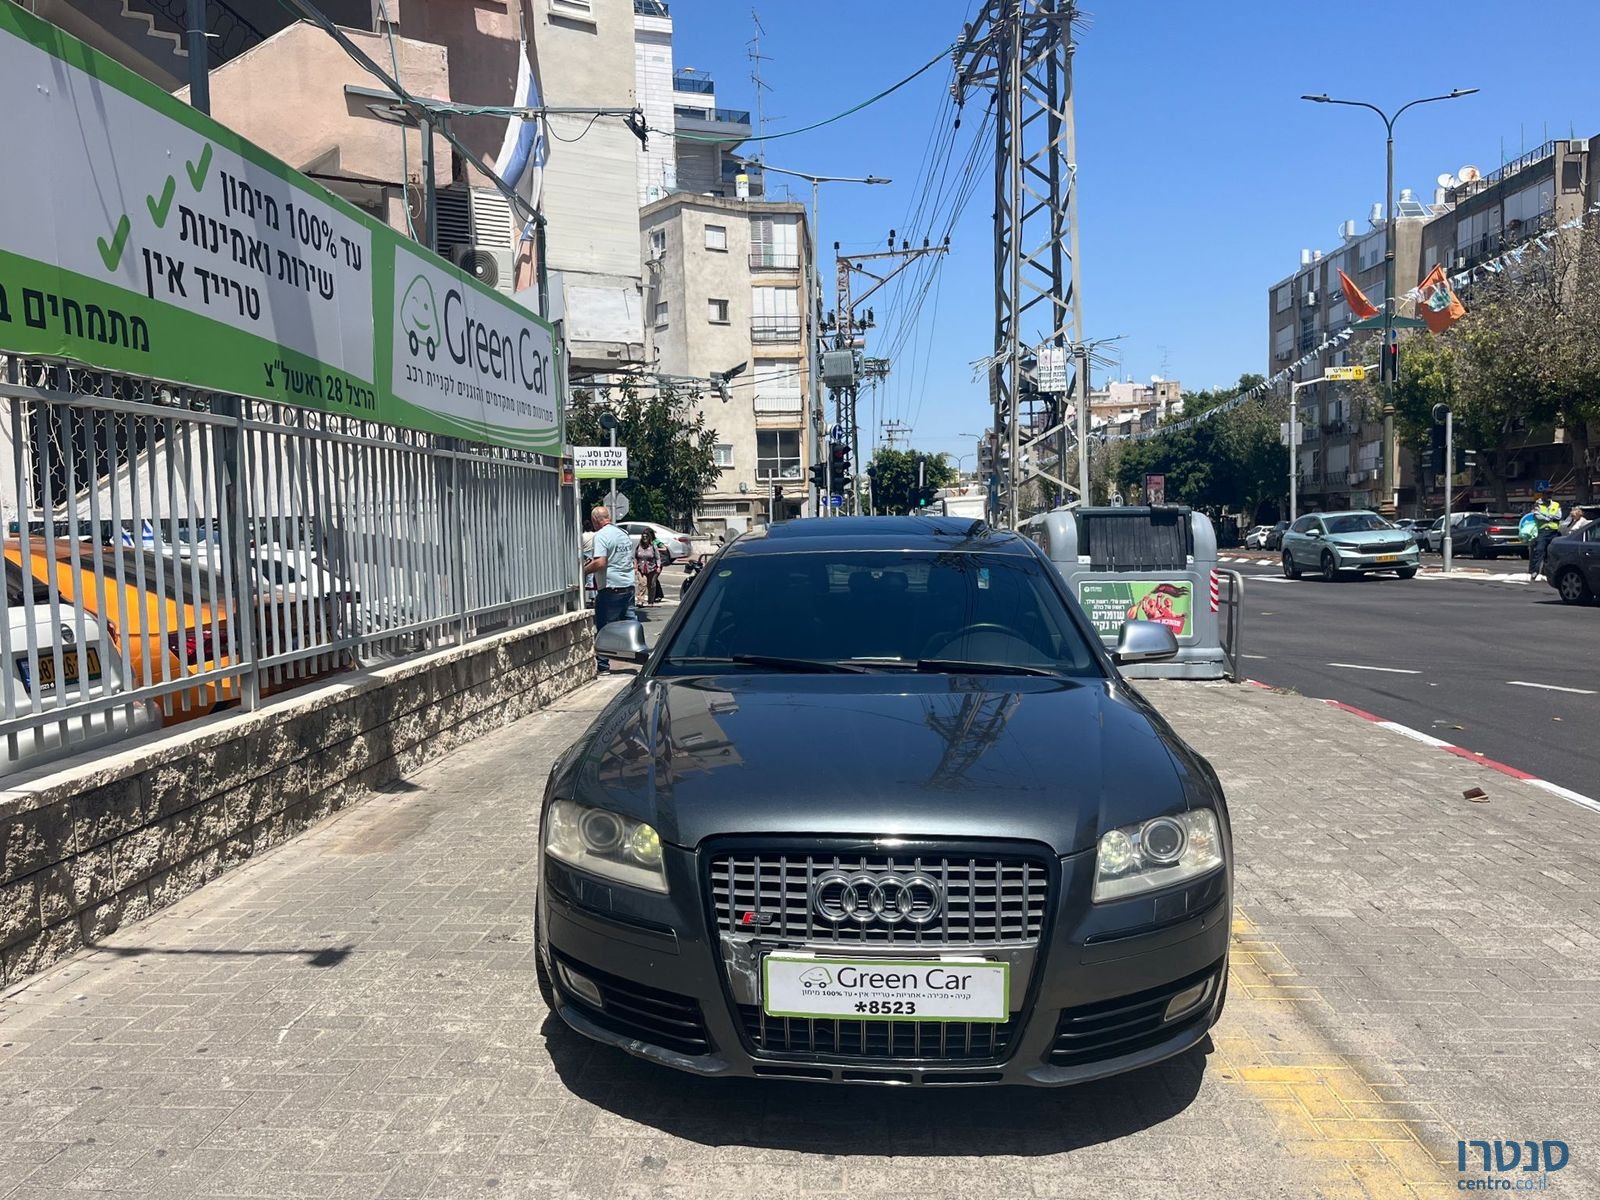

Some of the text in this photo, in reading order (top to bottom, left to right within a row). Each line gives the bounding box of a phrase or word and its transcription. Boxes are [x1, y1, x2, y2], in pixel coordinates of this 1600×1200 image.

[219, 170, 362, 272] עד 100% מימון
[179, 204, 335, 301] שירות ואמינות
[142, 246, 261, 321] טרייד אין
[22, 287, 150, 354] מתמחים
[443, 288, 549, 397] Green Car
[406, 364, 424, 385] רכב
[426, 372, 455, 397] לקניית
[326, 373, 344, 403] 28
[345, 378, 376, 412] הרצל
[457, 381, 484, 403] והוגנים
[485, 390, 515, 413] מתקדמים
[588, 459, 598, 467] זה
[600, 458, 623, 467] אצלנו
[603, 449, 622, 458] שלם
[1092, 611, 1125, 620] שומרים
[837, 966, 972, 990] Green Car
[801, 989, 820, 997] מימון
[858, 990, 869, 998] אין
[871, 990, 890, 998] טרייד
[895, 991, 921, 999] אחריות
[927, 992, 949, 1000] מכירה
